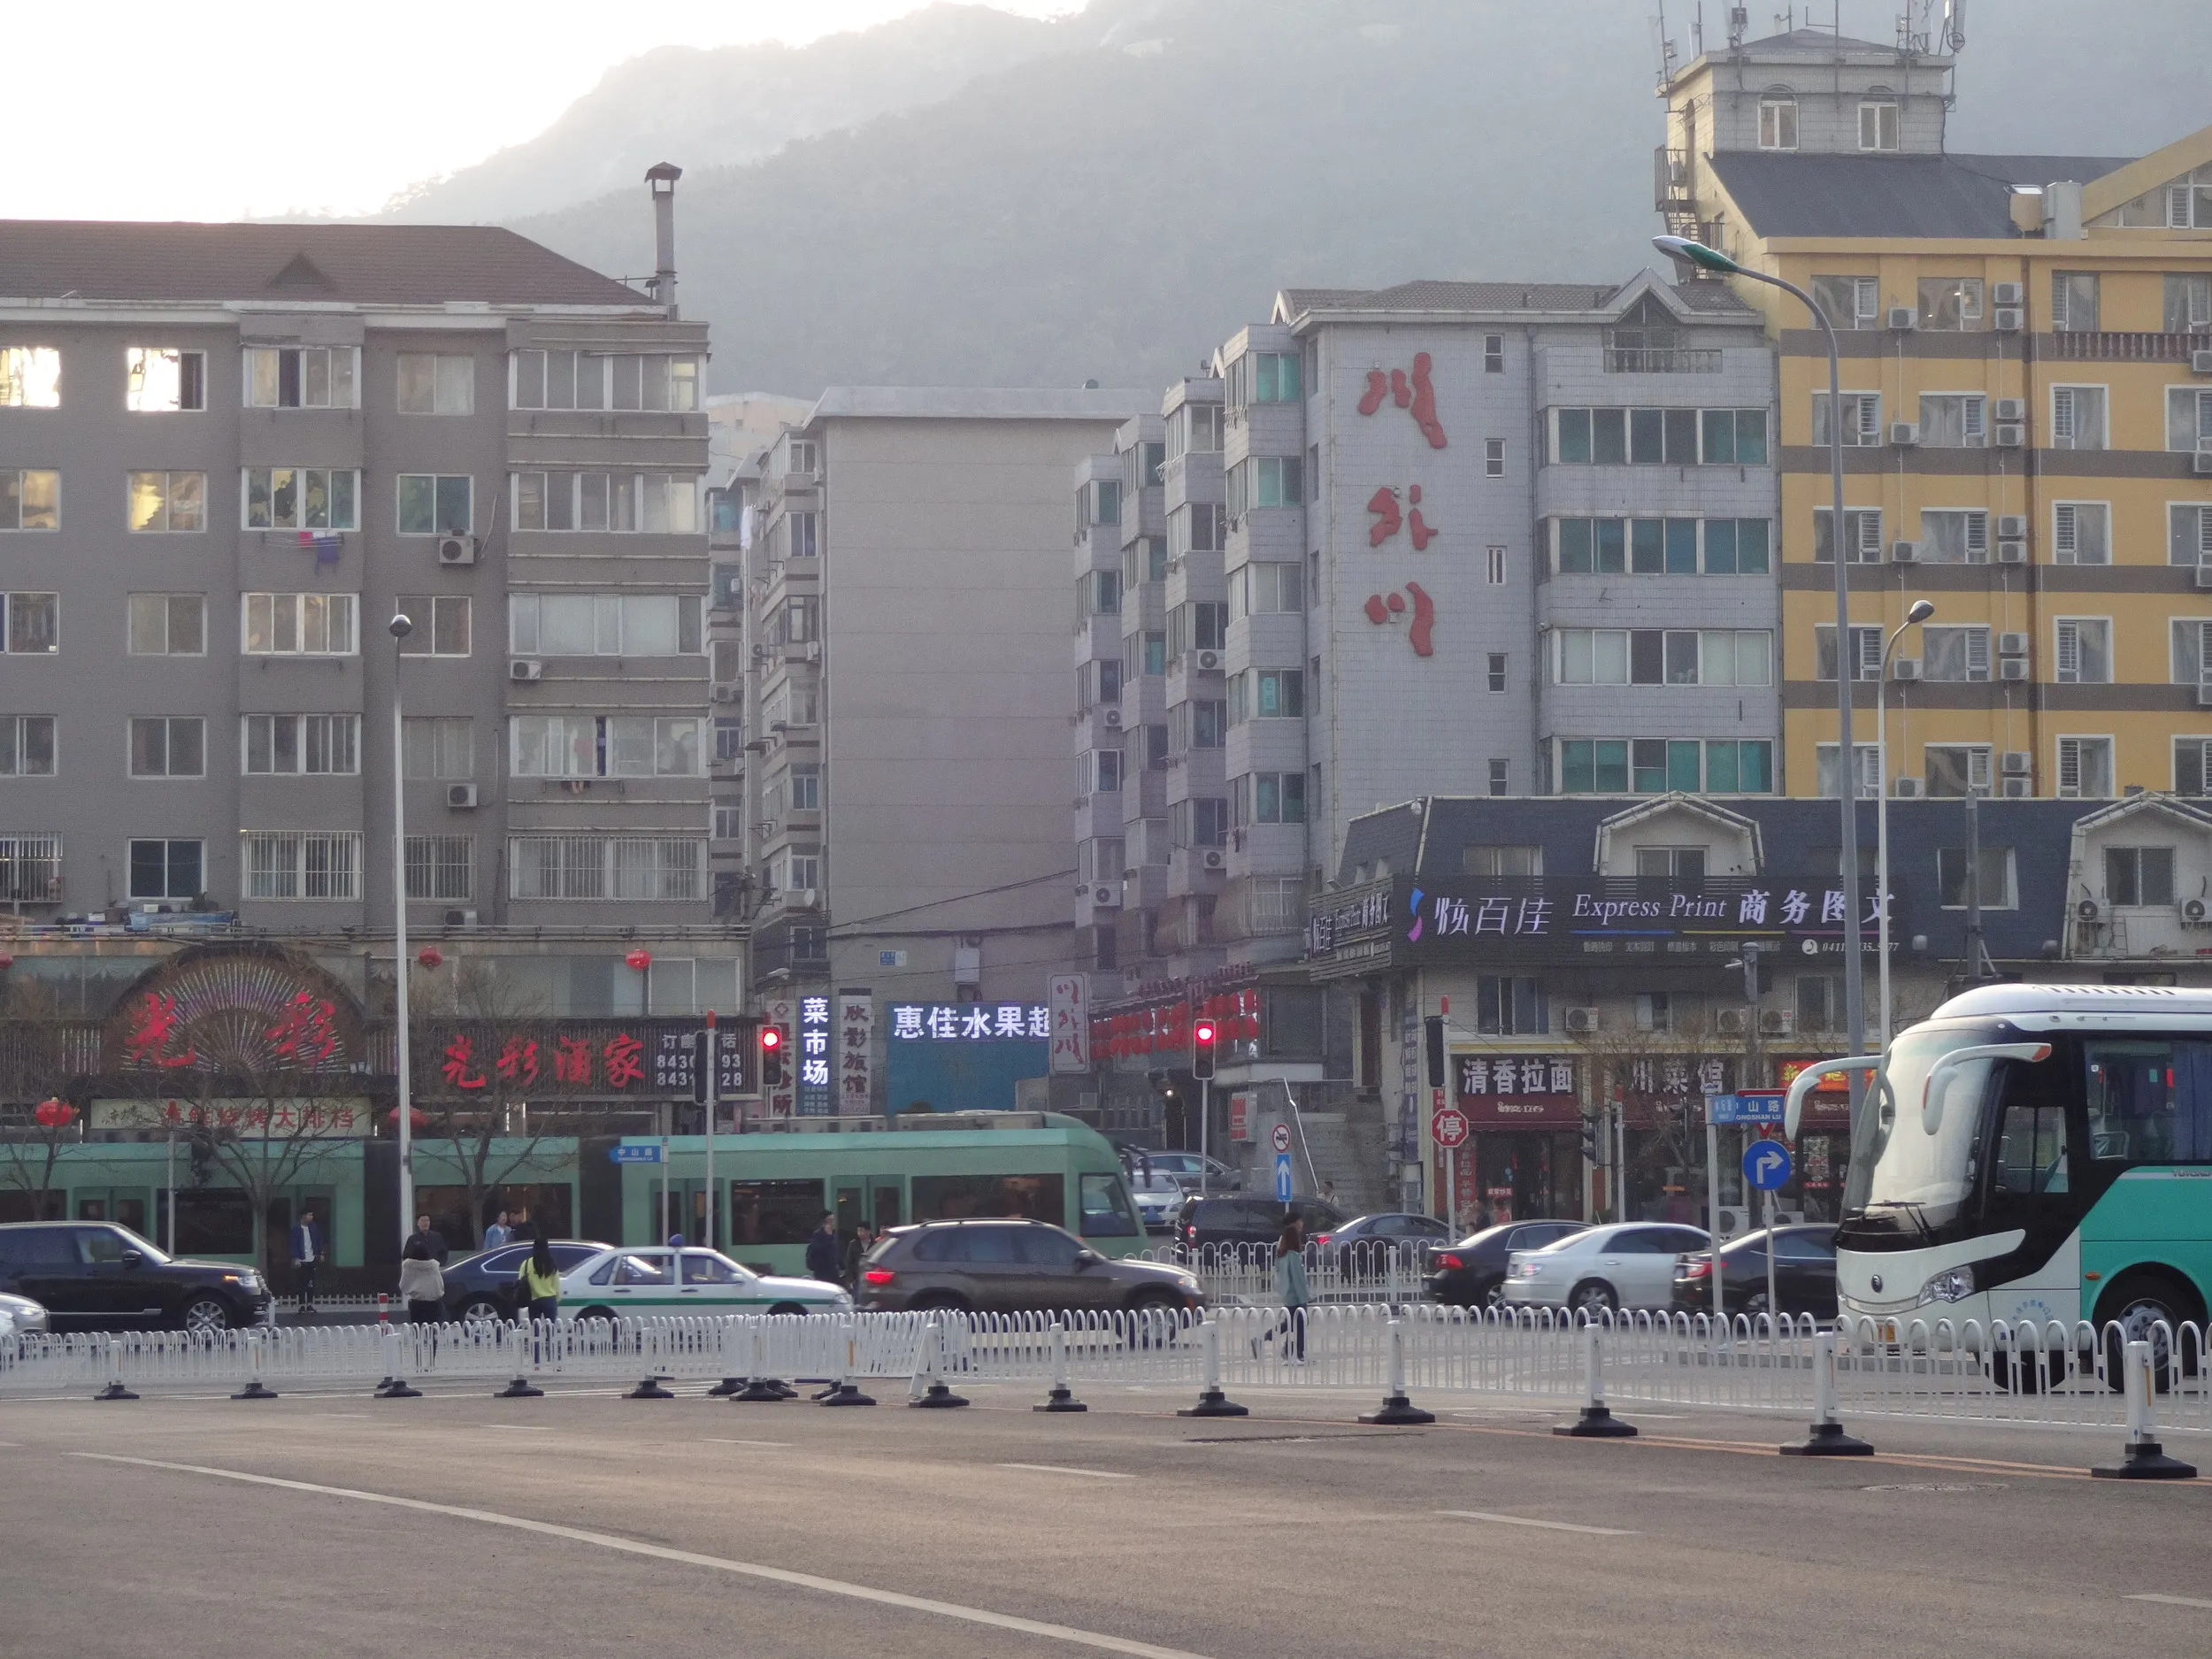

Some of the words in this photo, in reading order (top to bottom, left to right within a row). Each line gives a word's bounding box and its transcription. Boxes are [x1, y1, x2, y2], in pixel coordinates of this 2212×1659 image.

[1572, 894, 1660, 926] Express
[1670, 894, 1728, 918] Print
[893, 1005, 1049, 1039] 惠佳水果超
[803, 997, 828, 1085] 菜市场
[1463, 1058, 1573, 1094] 清香拉面
[1736, 1100, 1779, 1112] 山路
[1435, 1115, 1463, 1141] 停
